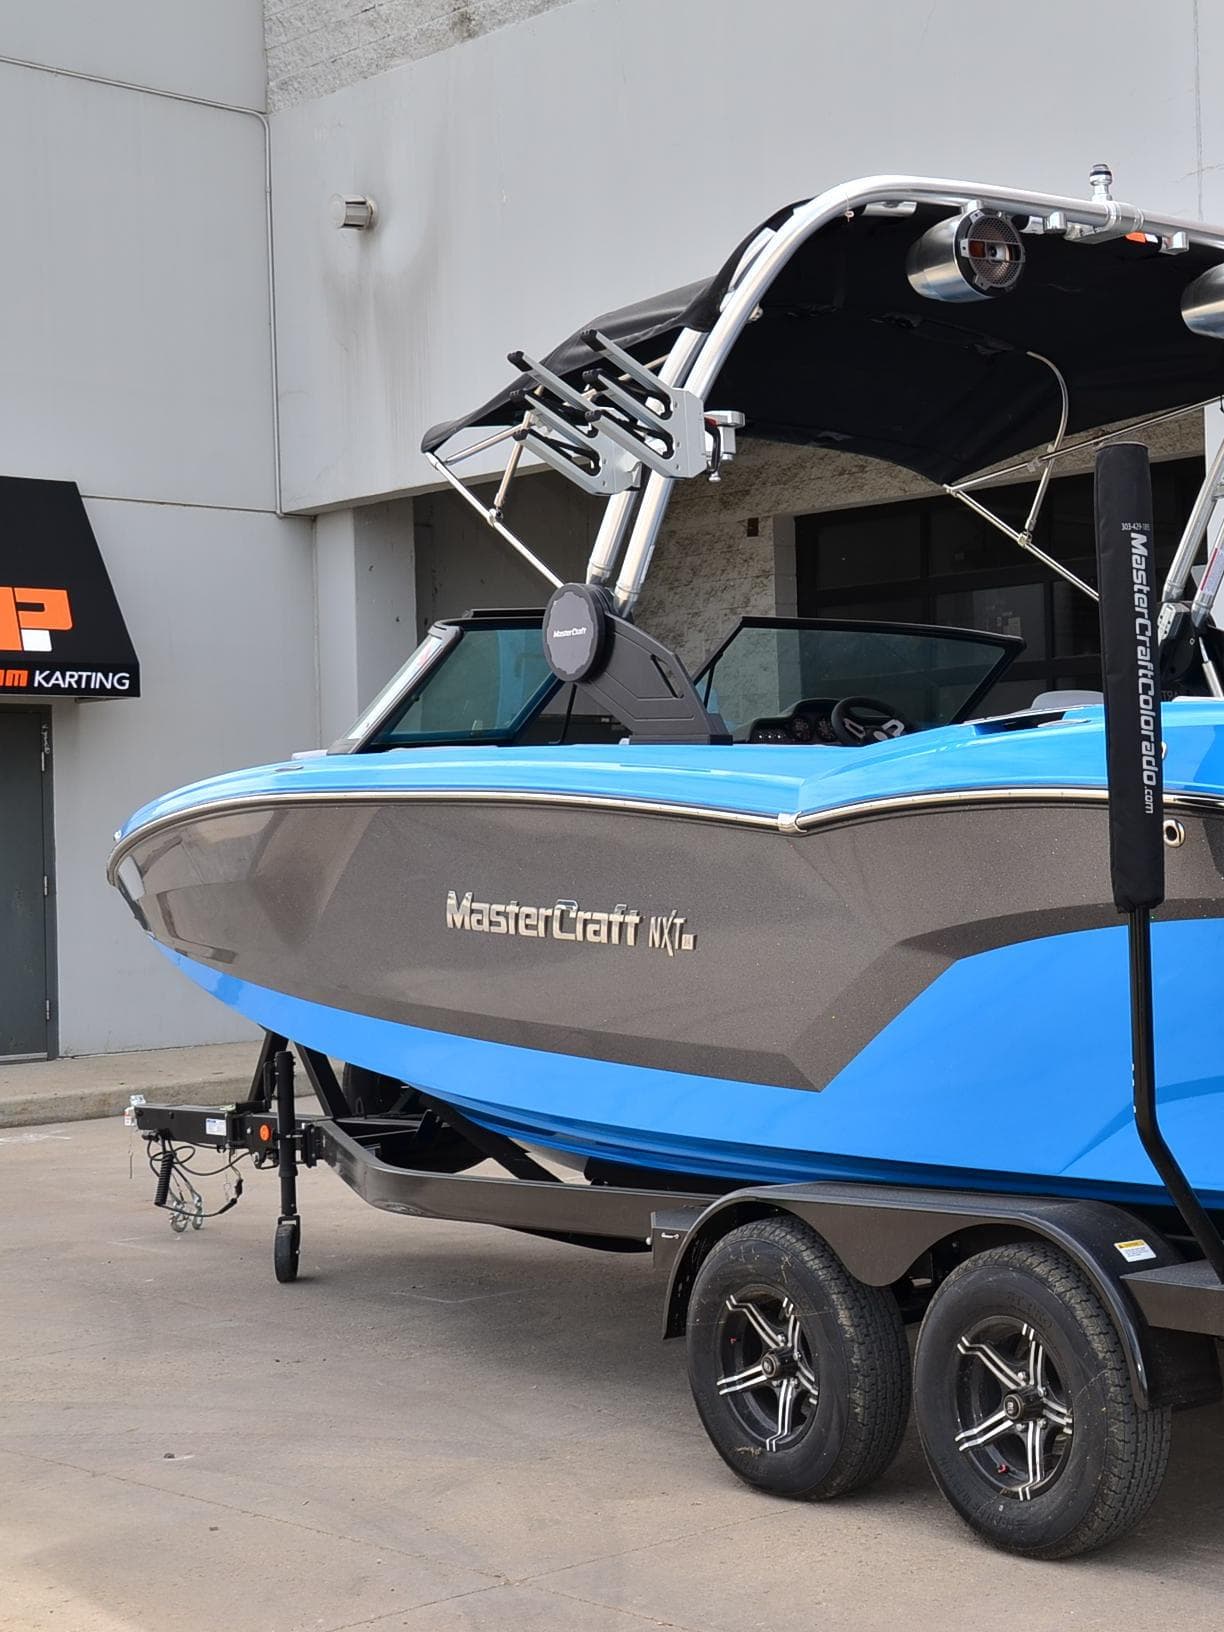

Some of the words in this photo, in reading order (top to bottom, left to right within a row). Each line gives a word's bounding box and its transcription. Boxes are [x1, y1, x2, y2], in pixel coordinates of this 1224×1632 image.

[33, 670, 130, 689] KARTING
[1131, 532, 1158, 814] MasterCraftColorado.com
[446, 890, 641, 946] MasterCraft
